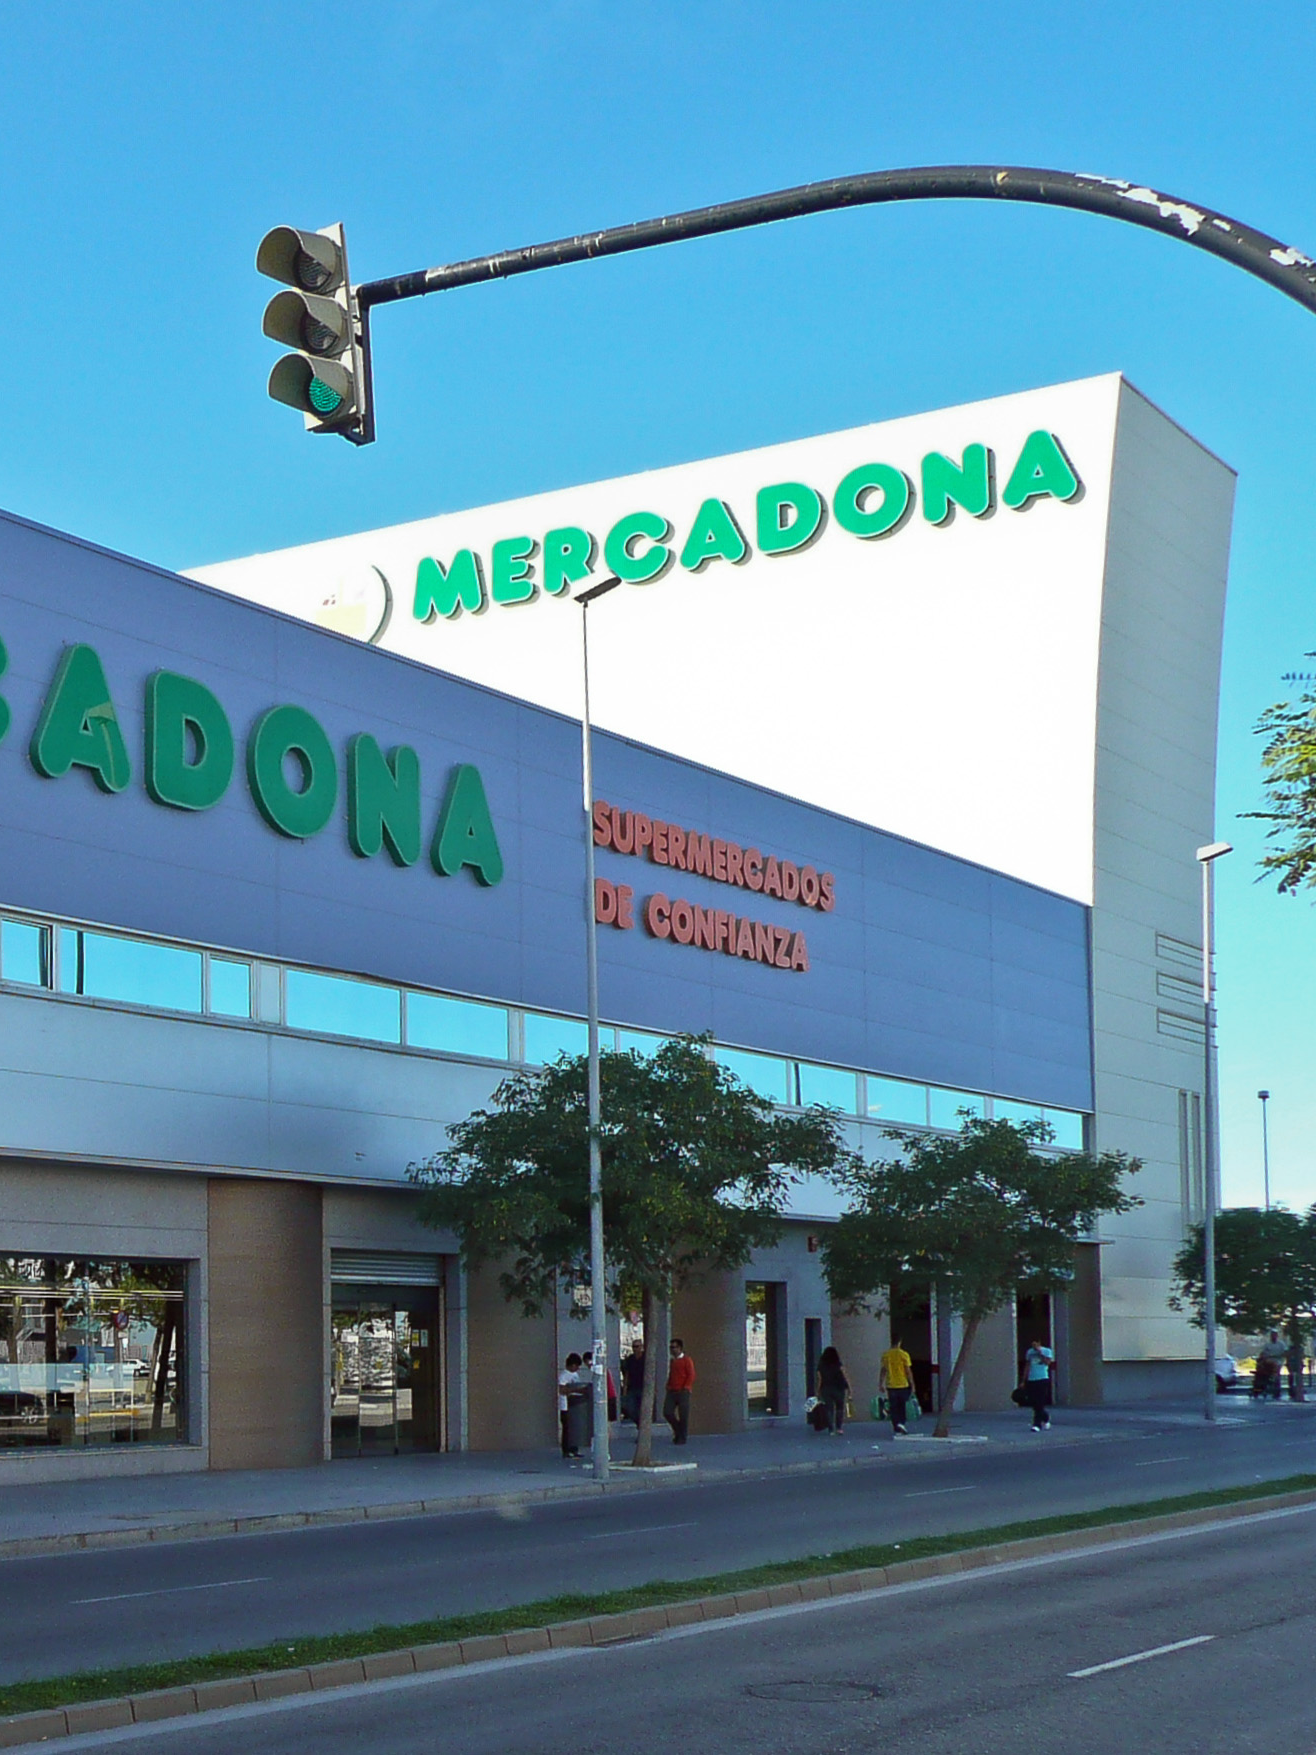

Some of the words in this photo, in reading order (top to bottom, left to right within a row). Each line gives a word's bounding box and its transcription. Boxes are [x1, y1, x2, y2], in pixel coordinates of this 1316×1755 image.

[412, 428, 1082, 623] MERCADONA
[592, 799, 836, 913] SUPERMERCADOS
[594, 876, 634, 930] DE
[644, 891, 811, 973] CONFIANZA
